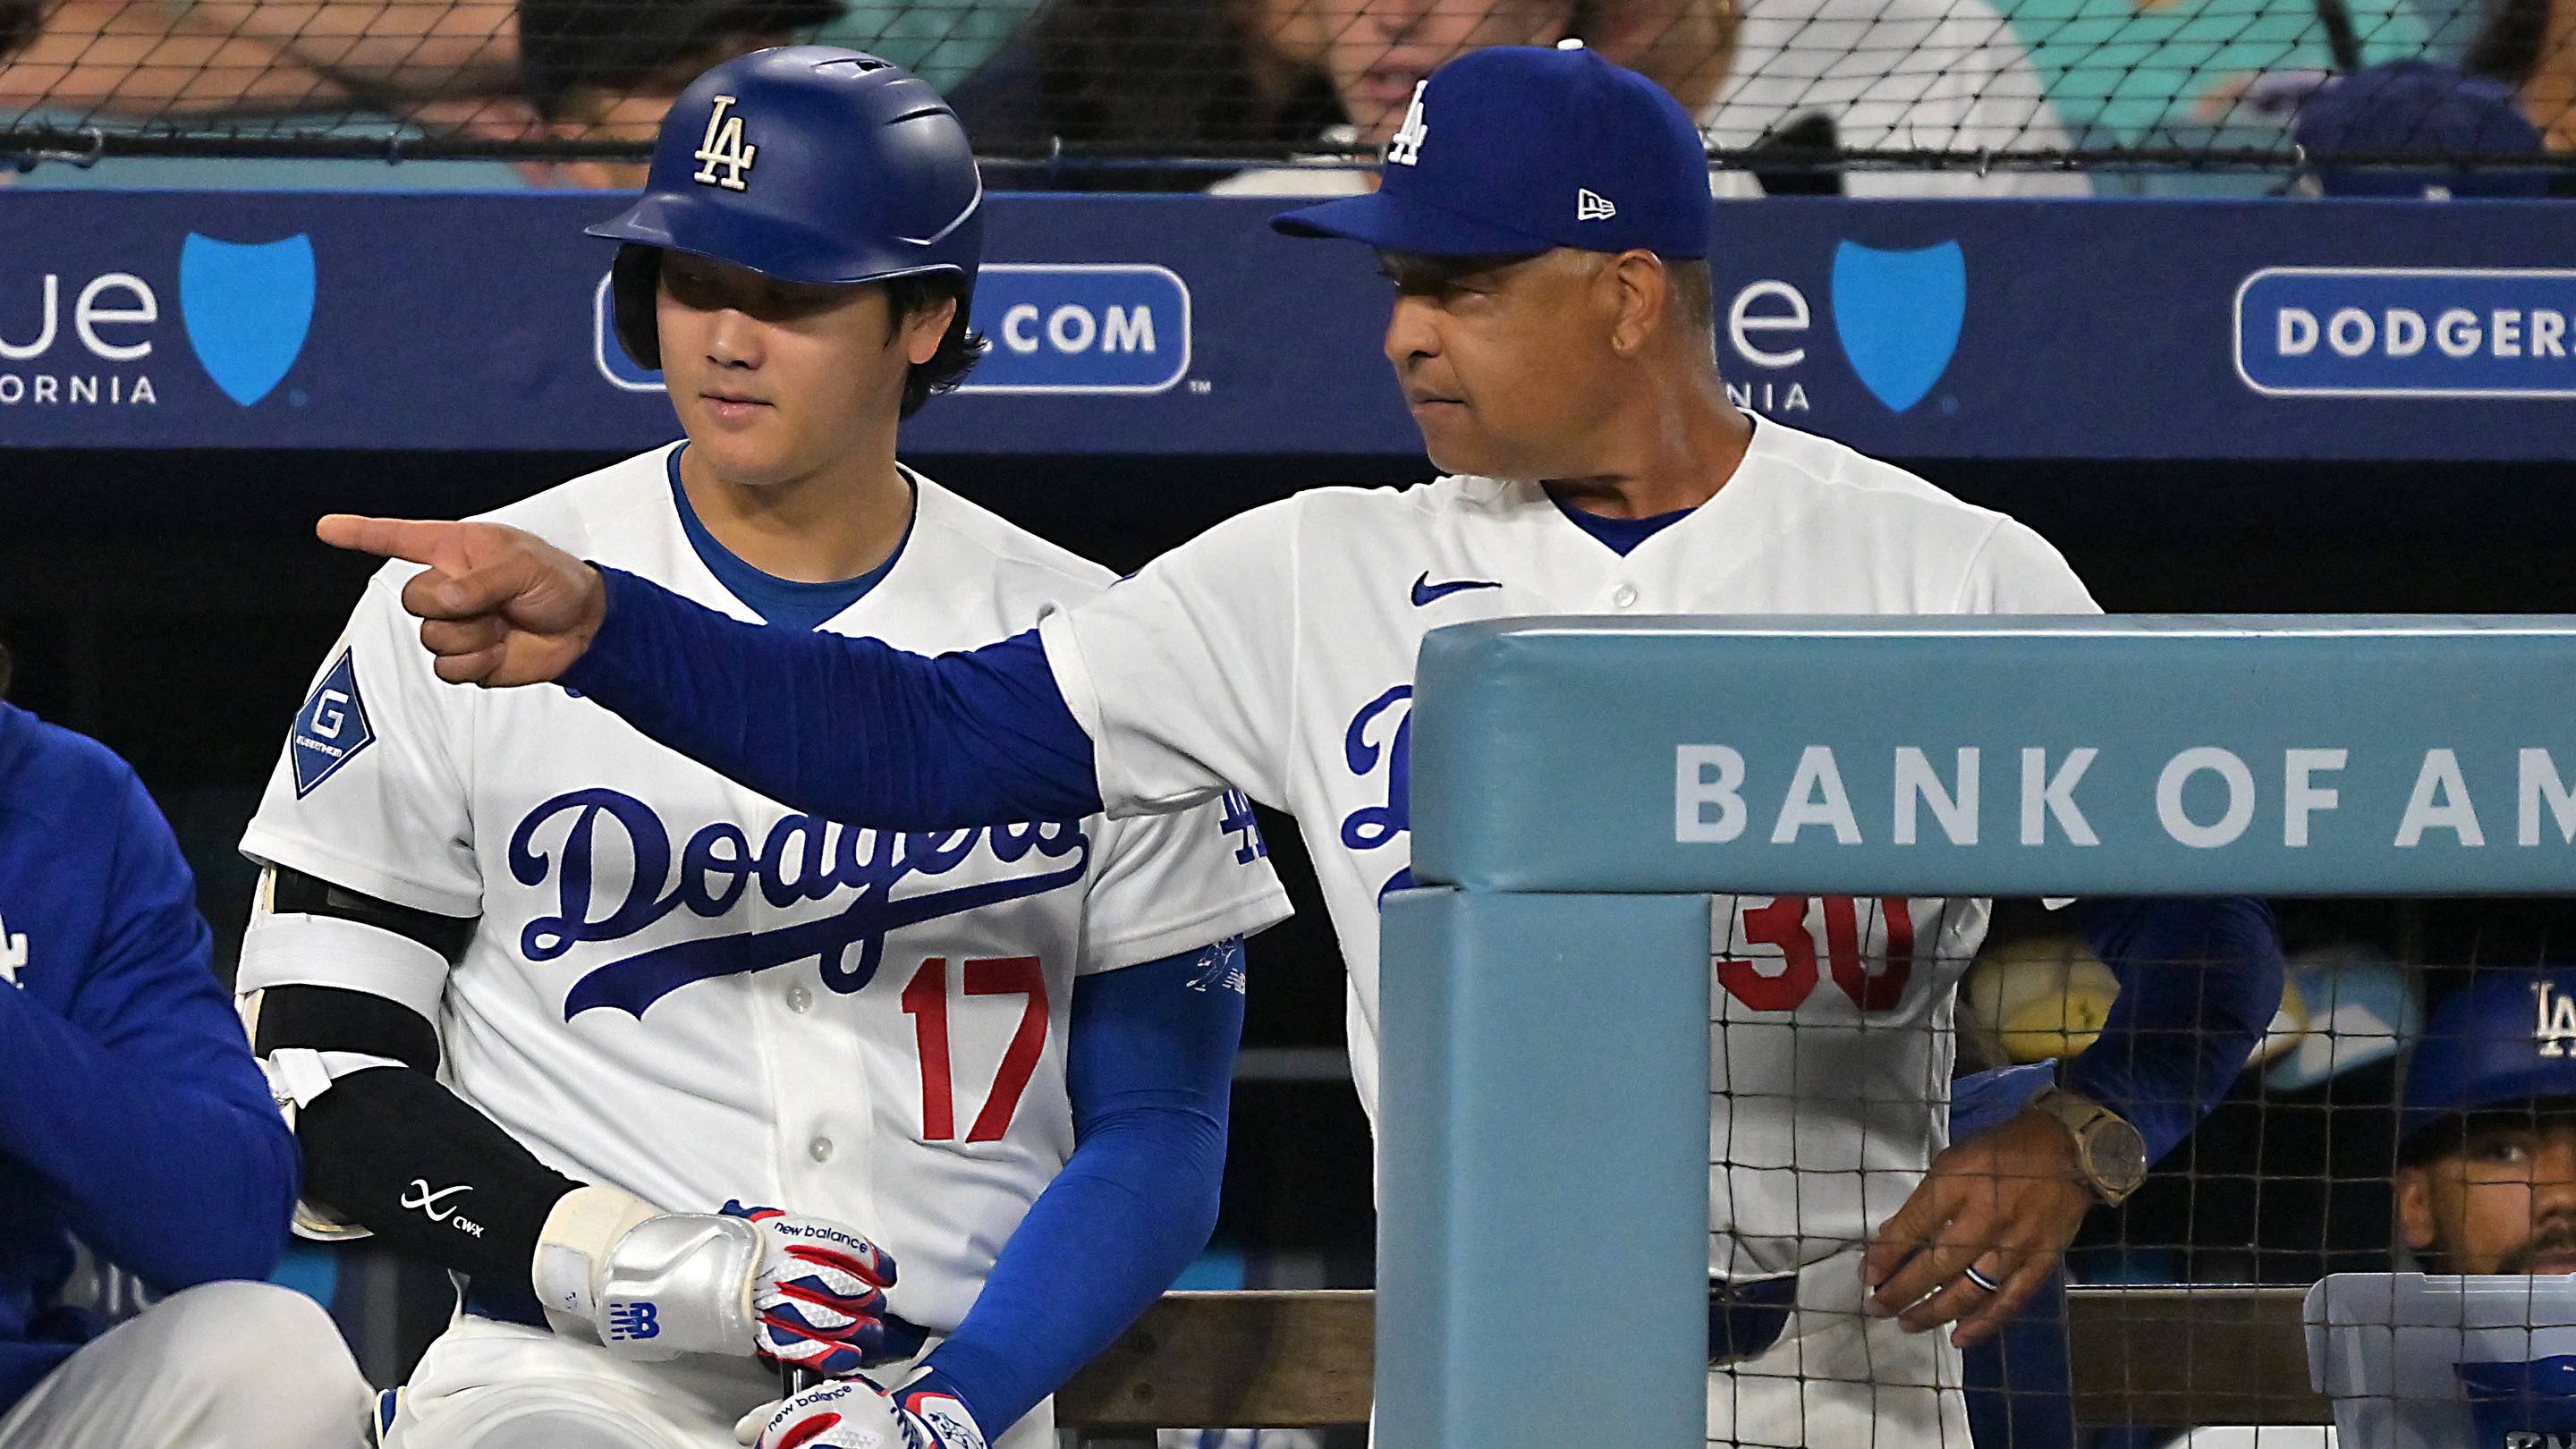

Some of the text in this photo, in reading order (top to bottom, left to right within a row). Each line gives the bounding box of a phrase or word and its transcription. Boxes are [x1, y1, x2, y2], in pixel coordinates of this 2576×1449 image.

[693, 94, 756, 191] LA
[2277, 307, 2576, 358] DODGER
[310, 688, 350, 739] G
[1674, 744, 2101, 847] BANK
[2156, 746, 2350, 849] OF
[901, 955, 1049, 1144] 17
[774, 1221, 868, 1254] new balance
[767, 1384, 852, 1432] new balance
